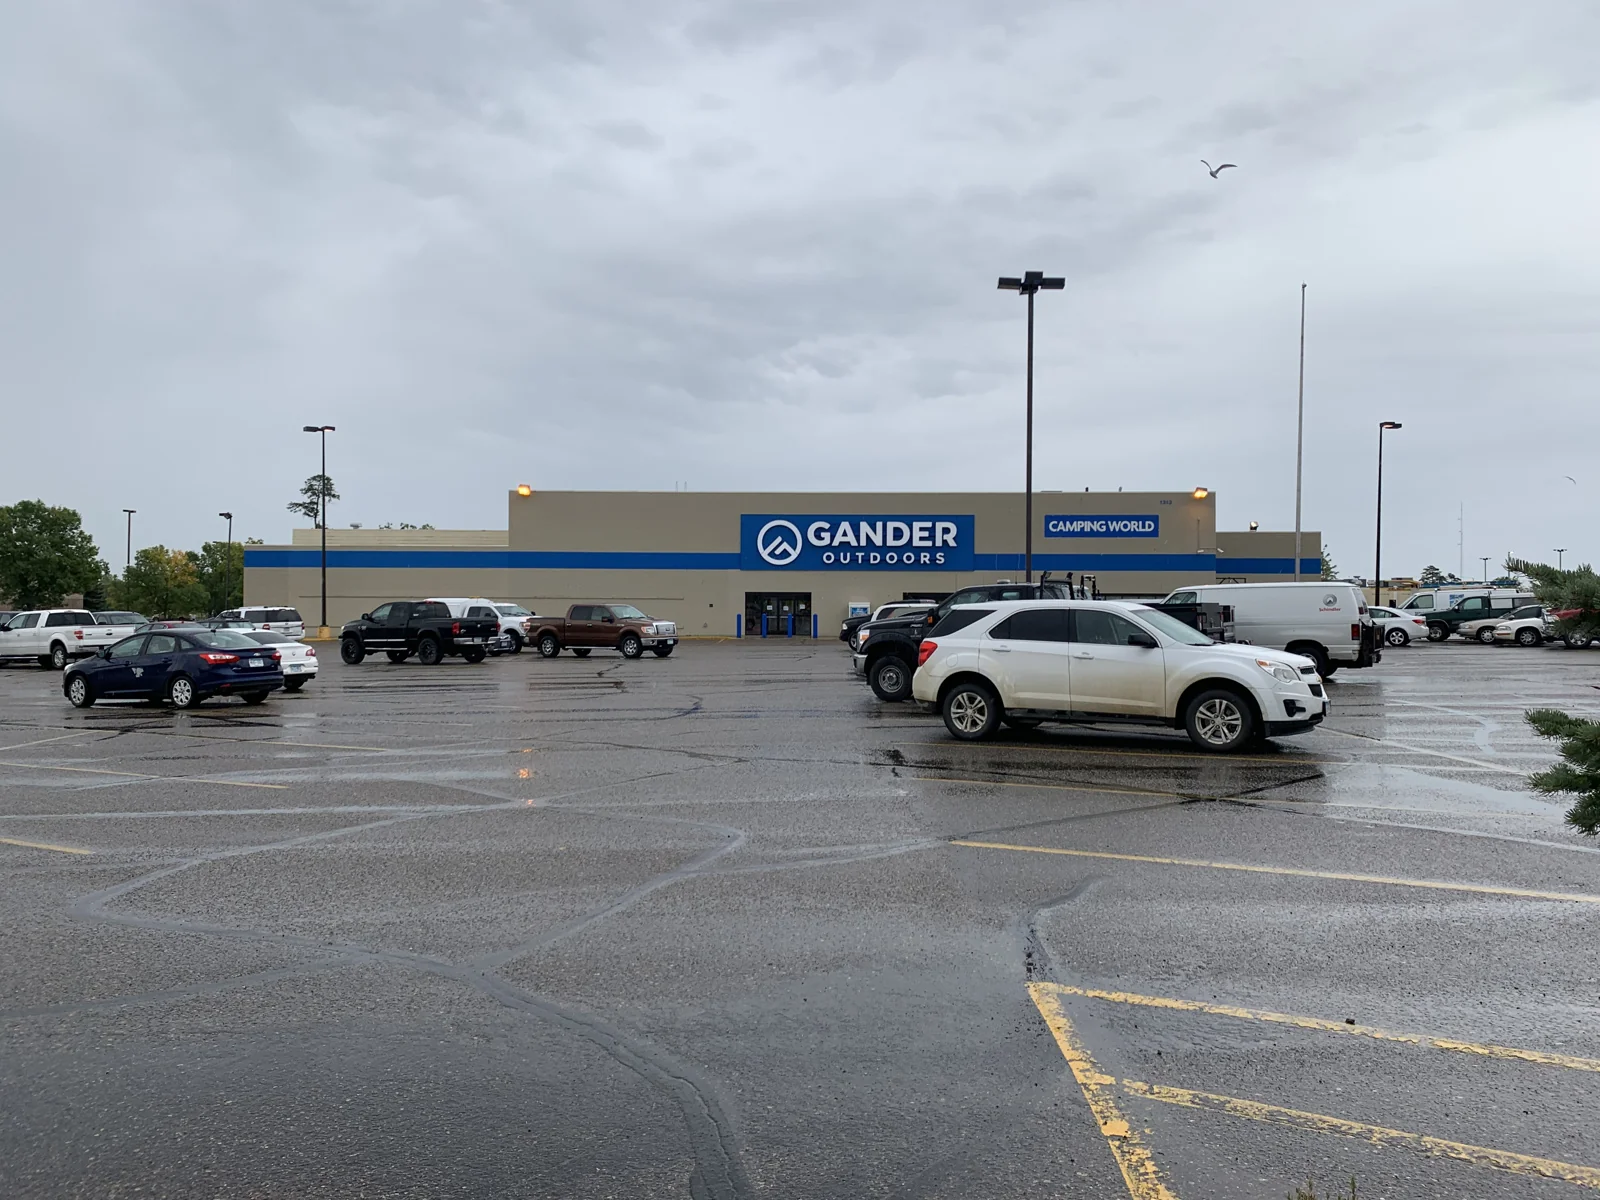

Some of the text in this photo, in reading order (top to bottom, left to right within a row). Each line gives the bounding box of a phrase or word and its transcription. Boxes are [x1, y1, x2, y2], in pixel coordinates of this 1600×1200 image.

[1049, 520, 1155, 532] CAMPING WORLD
[807, 521, 957, 546] GANDER
[822, 552, 945, 564] OUTDOORS
